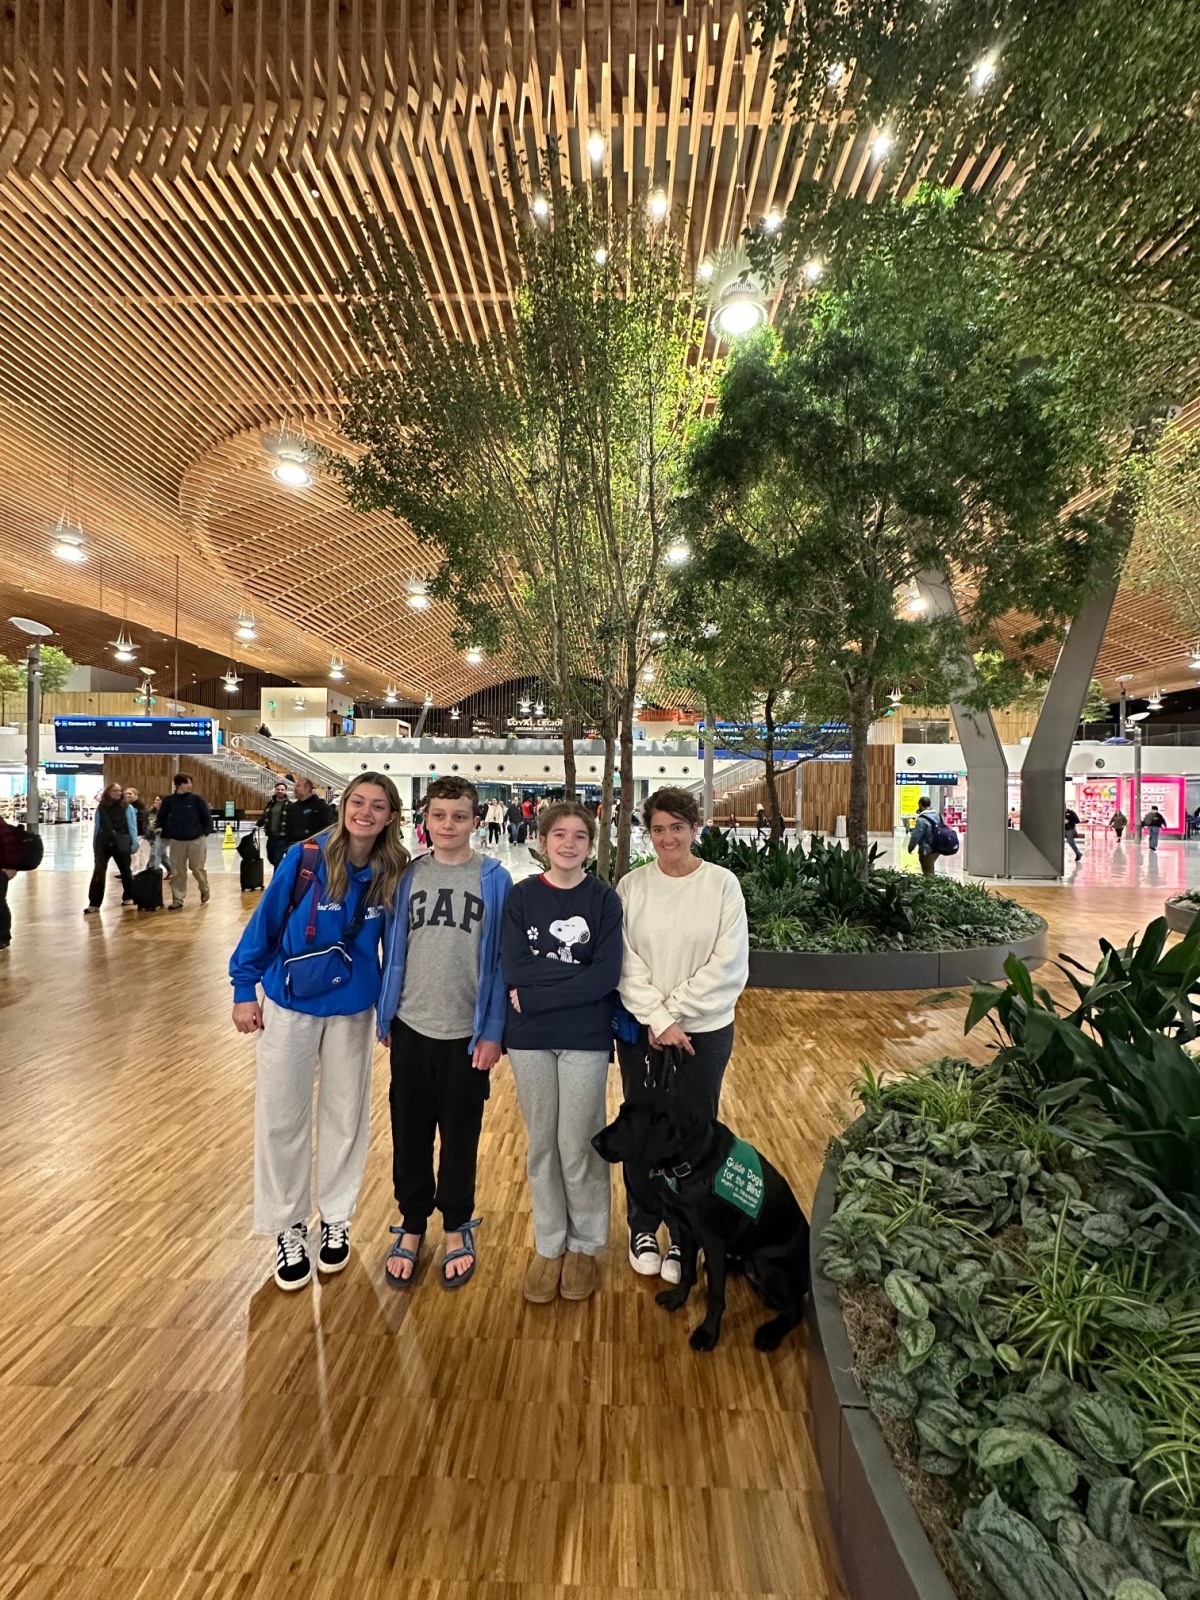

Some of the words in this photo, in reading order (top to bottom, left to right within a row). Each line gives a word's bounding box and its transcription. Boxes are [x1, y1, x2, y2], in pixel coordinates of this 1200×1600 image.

[507, 718, 535, 726] LOYAL
[409, 888, 484, 933] GAP
[723, 1168, 734, 1180] for
[735, 1175, 745, 1187] the
[746, 1182, 762, 1198] Blind
[726, 1157, 745, 1174] Guide
[747, 1169, 763, 1186] Dogs
